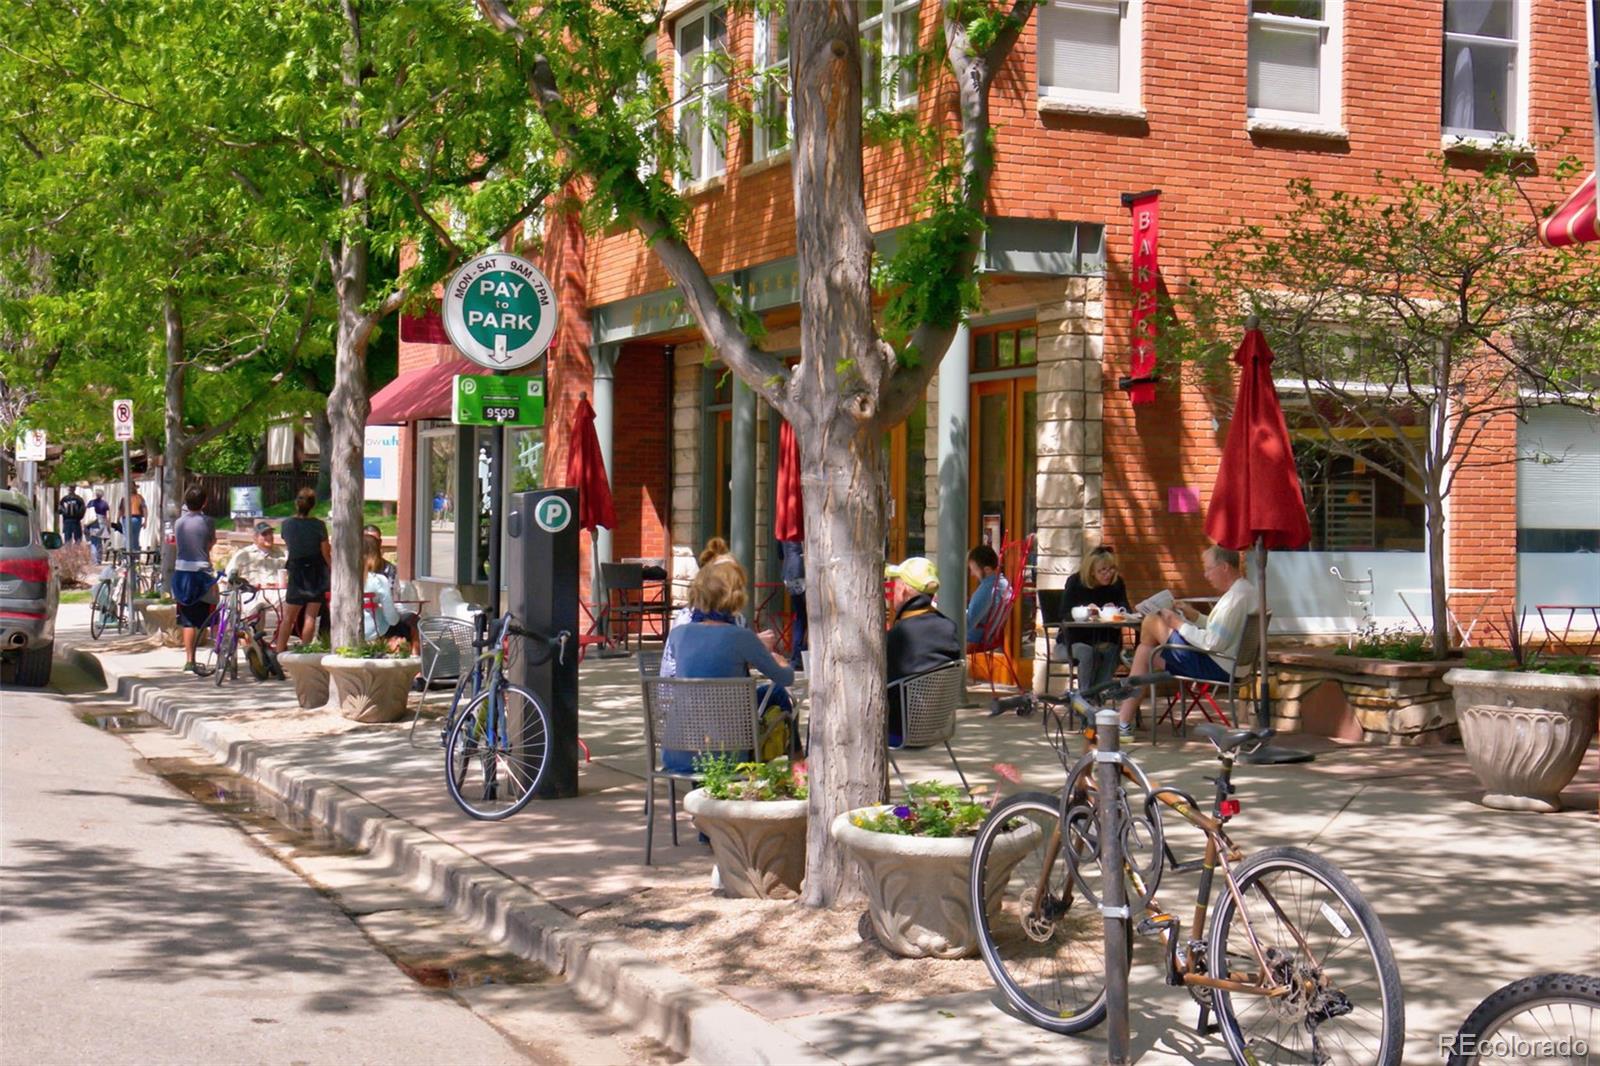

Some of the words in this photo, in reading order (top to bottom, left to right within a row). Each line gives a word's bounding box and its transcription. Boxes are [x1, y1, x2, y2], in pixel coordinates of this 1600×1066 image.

[455, 273, 473, 299] MON
[477, 259, 497, 273] SAT
[480, 280, 524, 298] PAY
[510, 261, 533, 279] 9AM
[534, 281, 550, 306] 7PM
[1138, 211, 1151, 365] BAKERY
[496, 301, 509, 309] to
[468, 310, 533, 331] PARK
[486, 407, 515, 419] 9599
